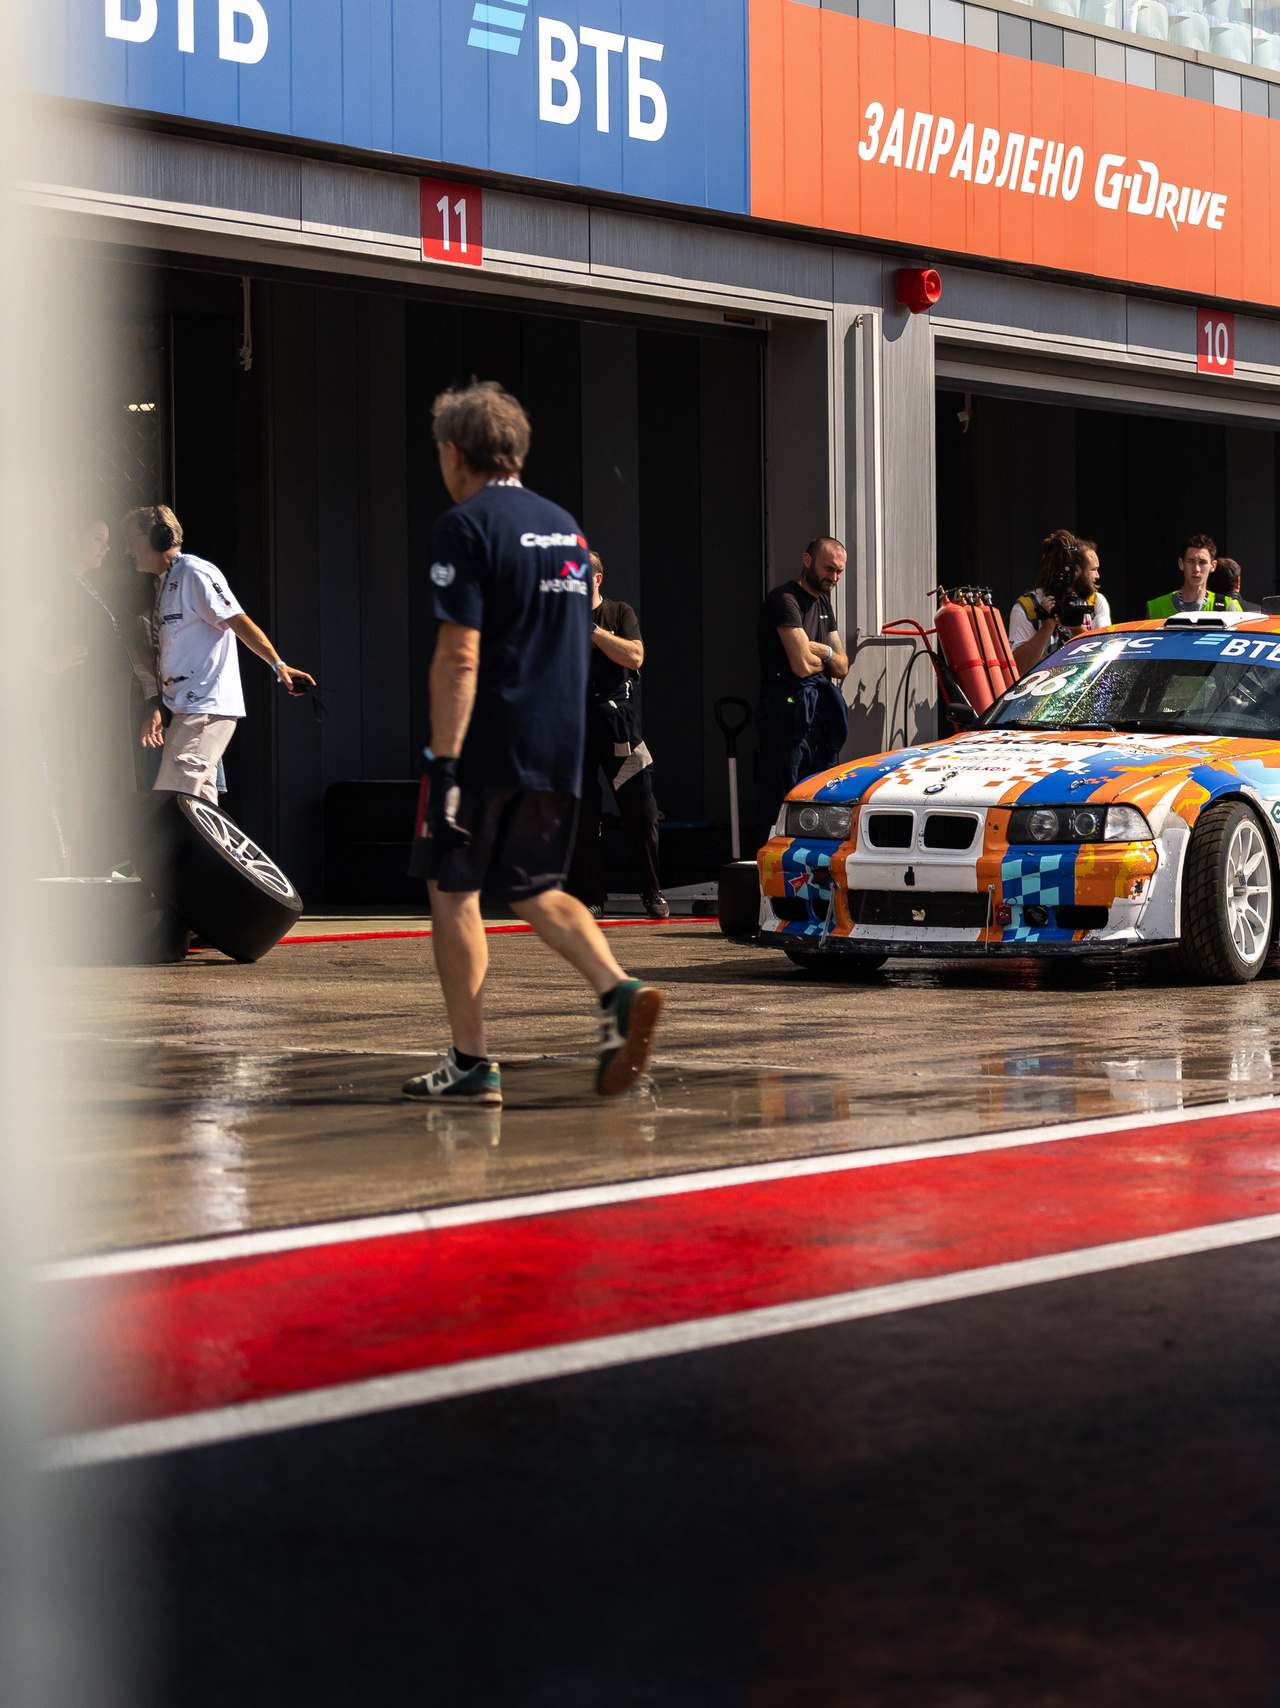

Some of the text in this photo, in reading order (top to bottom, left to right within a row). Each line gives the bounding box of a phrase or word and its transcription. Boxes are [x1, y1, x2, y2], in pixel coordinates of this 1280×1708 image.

[537, 17, 668, 142] ВТБ
[858, 101, 1084, 202] ЗАПРАВЛЕНО
[436, 195, 468, 254] 11
[1203, 320, 1228, 367] 10
[1003, 667, 1079, 701] 36
